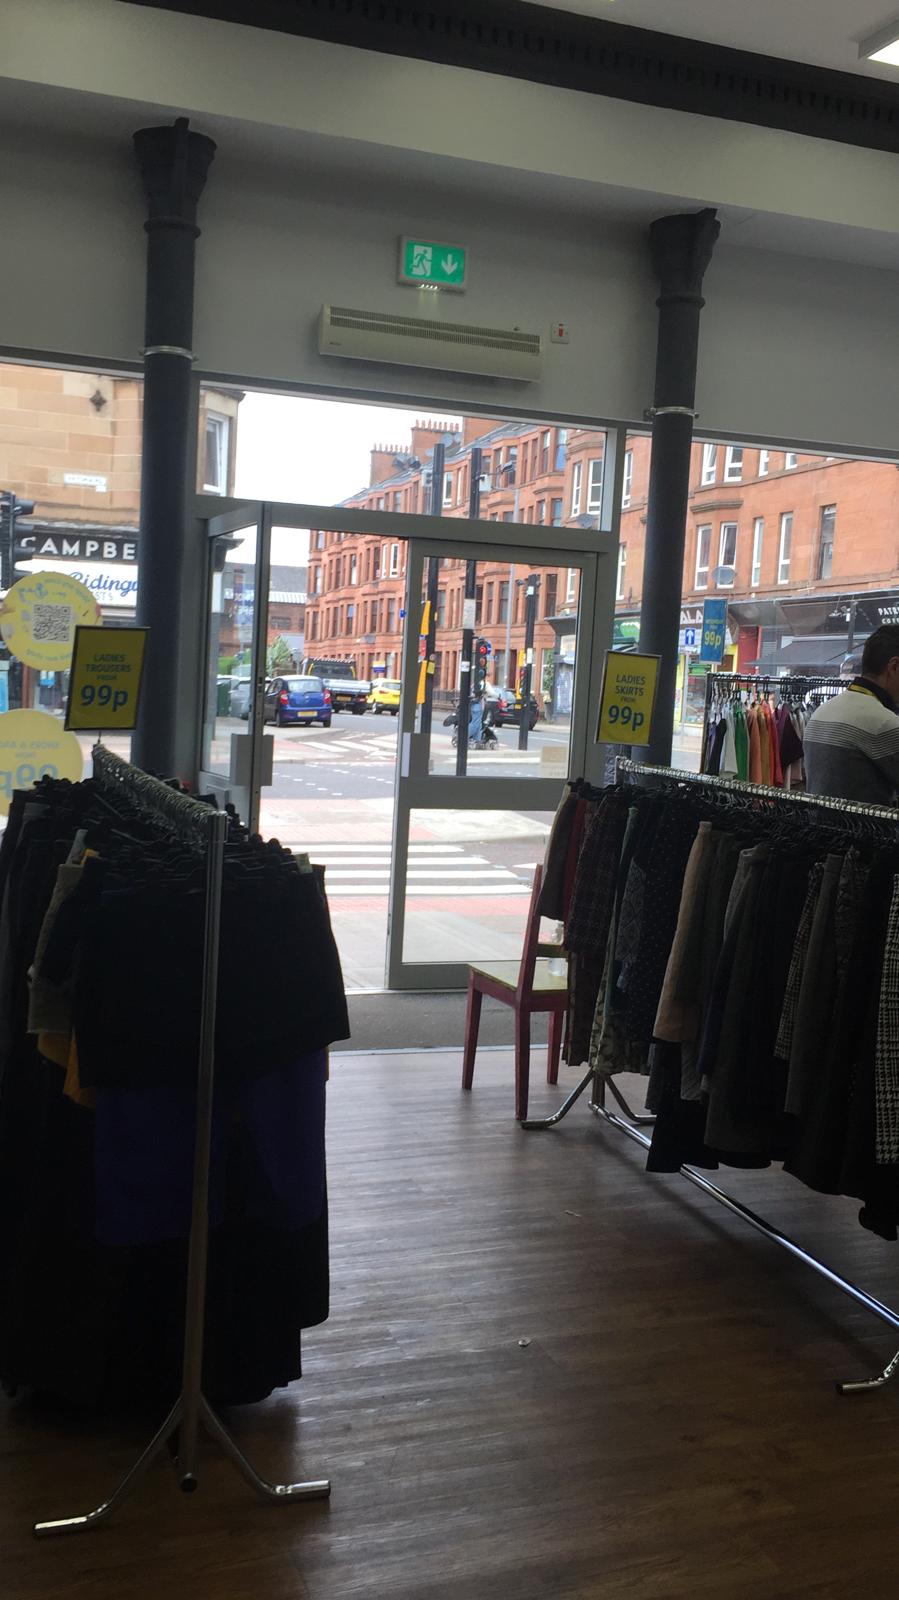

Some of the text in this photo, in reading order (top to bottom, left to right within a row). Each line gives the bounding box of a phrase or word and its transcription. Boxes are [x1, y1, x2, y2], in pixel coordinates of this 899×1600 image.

[20, 536, 136, 560] CAMPBE
[704, 630, 721, 649] 99p
[616, 674, 646, 686] LADIES
[80, 684, 129, 713] 99p
[615, 685, 645, 697] SKIRTS
[608, 704, 645, 732] 99p
